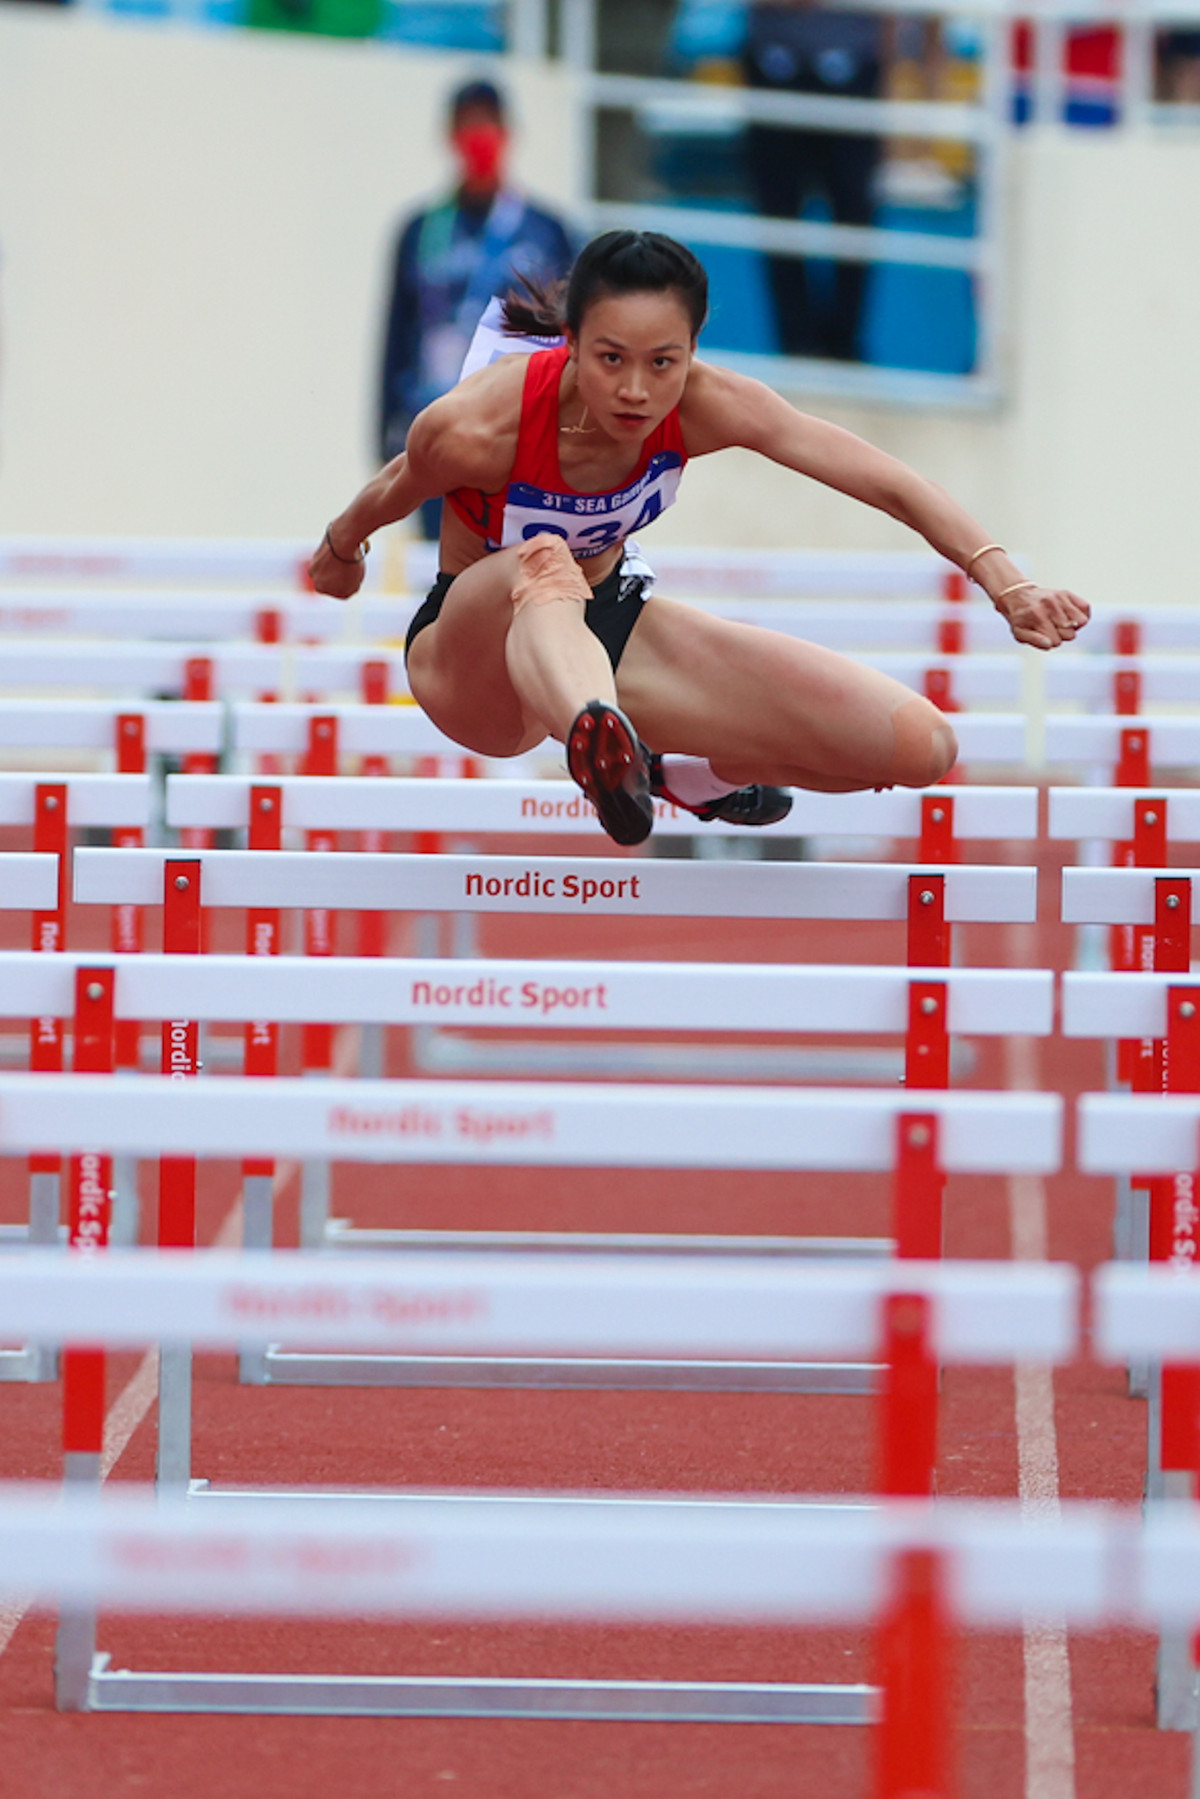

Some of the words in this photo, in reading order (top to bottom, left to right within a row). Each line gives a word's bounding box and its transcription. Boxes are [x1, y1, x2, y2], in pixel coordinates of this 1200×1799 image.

[574, 497, 607, 513] SEA
[562, 874, 640, 904] Sport
[520, 981, 608, 1014] Sport
[79, 1155, 105, 1217] ordic
[1174, 1173, 1199, 1236] ordic
